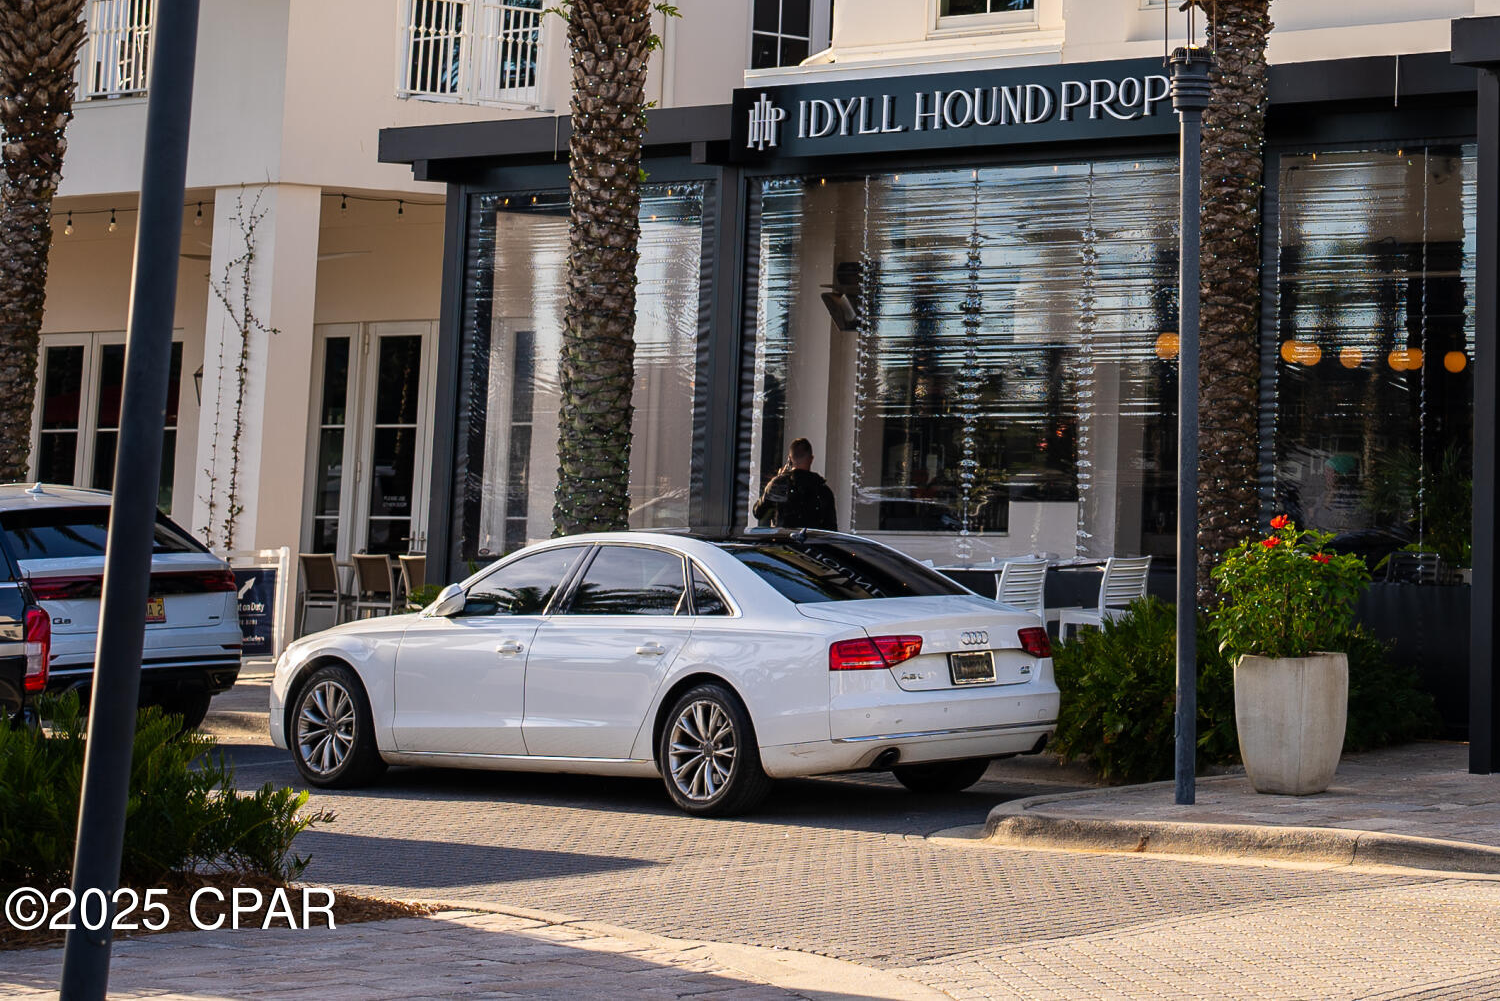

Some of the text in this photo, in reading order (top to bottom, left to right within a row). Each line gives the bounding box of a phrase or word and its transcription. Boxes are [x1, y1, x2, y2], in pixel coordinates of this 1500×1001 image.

[798, 75, 1179, 138] IDYLL HOUND PROP
